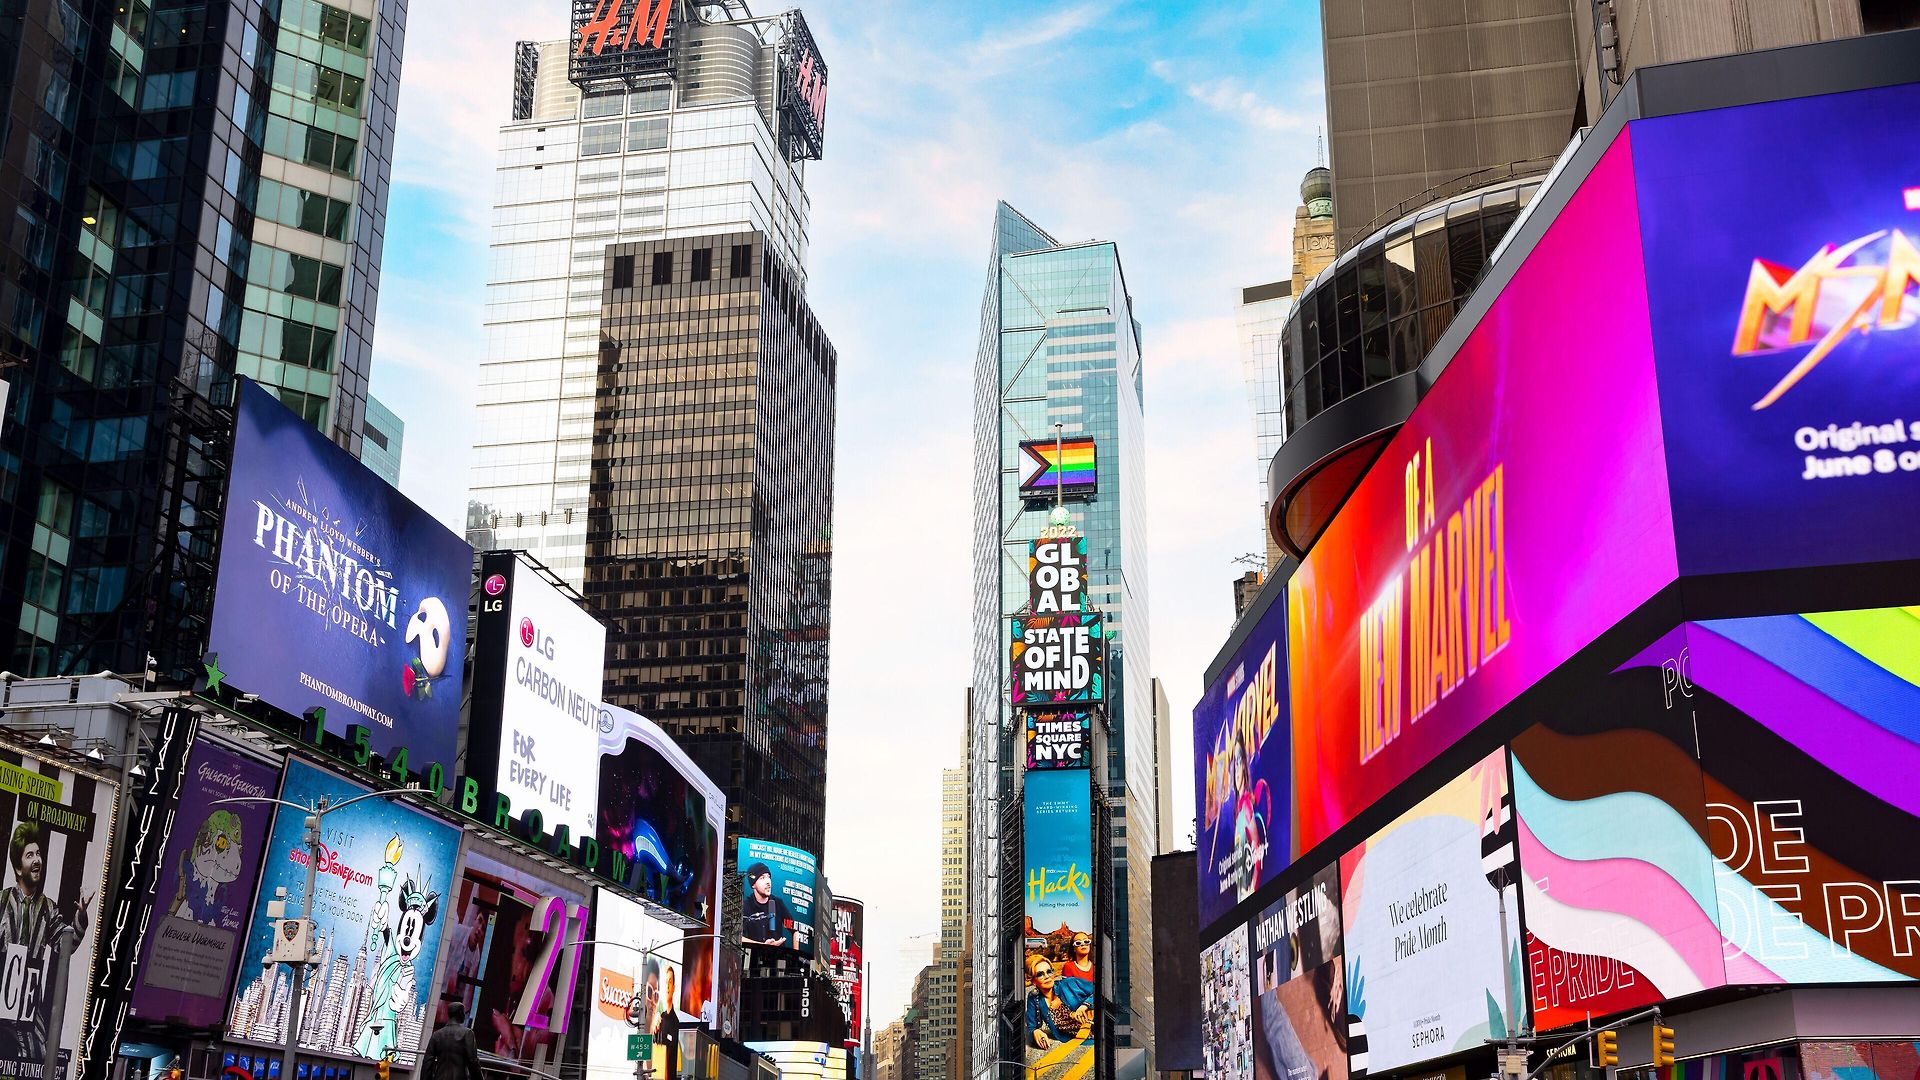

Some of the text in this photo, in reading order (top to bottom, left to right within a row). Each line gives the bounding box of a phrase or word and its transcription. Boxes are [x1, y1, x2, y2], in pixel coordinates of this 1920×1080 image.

[576, 0, 672, 56] H&M
[797, 48, 826, 132] H&M
[1795, 418, 1908, 452] Original
[1802, 454, 1873, 481] June
[1873, 448, 1897, 474] 8
[1405, 436, 1435, 553] OF A
[285, 499, 381, 568] ANDREW LLOYD WEBBER'S
[1040, 526, 1077, 539] 2022
[252, 499, 399, 630] PHANTOM
[270, 569, 379, 648] OF THE OPERA
[484, 600, 502, 612] LG
[1359, 462, 1511, 766] NEW MARVEL
[536, 629, 555, 661] LG
[1024, 626, 1090, 669] STATE
[1024, 646, 1061, 670] OF
[516, 656, 566, 712] CARBON
[1024, 655, 1090, 692] MIND
[299, 671, 394, 729] PHANTOMBROADWAY.COM
[513, 729, 536, 765] FOR
[1035, 721, 1082, 733] TIMES
[1035, 733, 1082, 746] SQUARE
[1036, 743, 1082, 760] NYC
[26, 776, 56, 801] SPIRITS
[510, 760, 572, 811] EVERY LIFE
[27, 800, 87, 833] ON BROADWAY!
[326, 827, 354, 848] VISIT
[325, 890, 337, 902] THE
[339, 895, 358, 908] MAGIC
[1027, 863, 1089, 903] Hacks
[320, 901, 327, 913] TO
[1256, 881, 1327, 953] NATHAN WESTLING
[1389, 882, 1448, 928] We celebrate
[1394, 915, 1448, 962] Pride Month
[524, 897, 590, 1034] 21
[1548, 930, 1635, 1008] PRIDE
[801, 978, 810, 1018] 1500
[1411, 1025, 1446, 1049] SEPHORA
